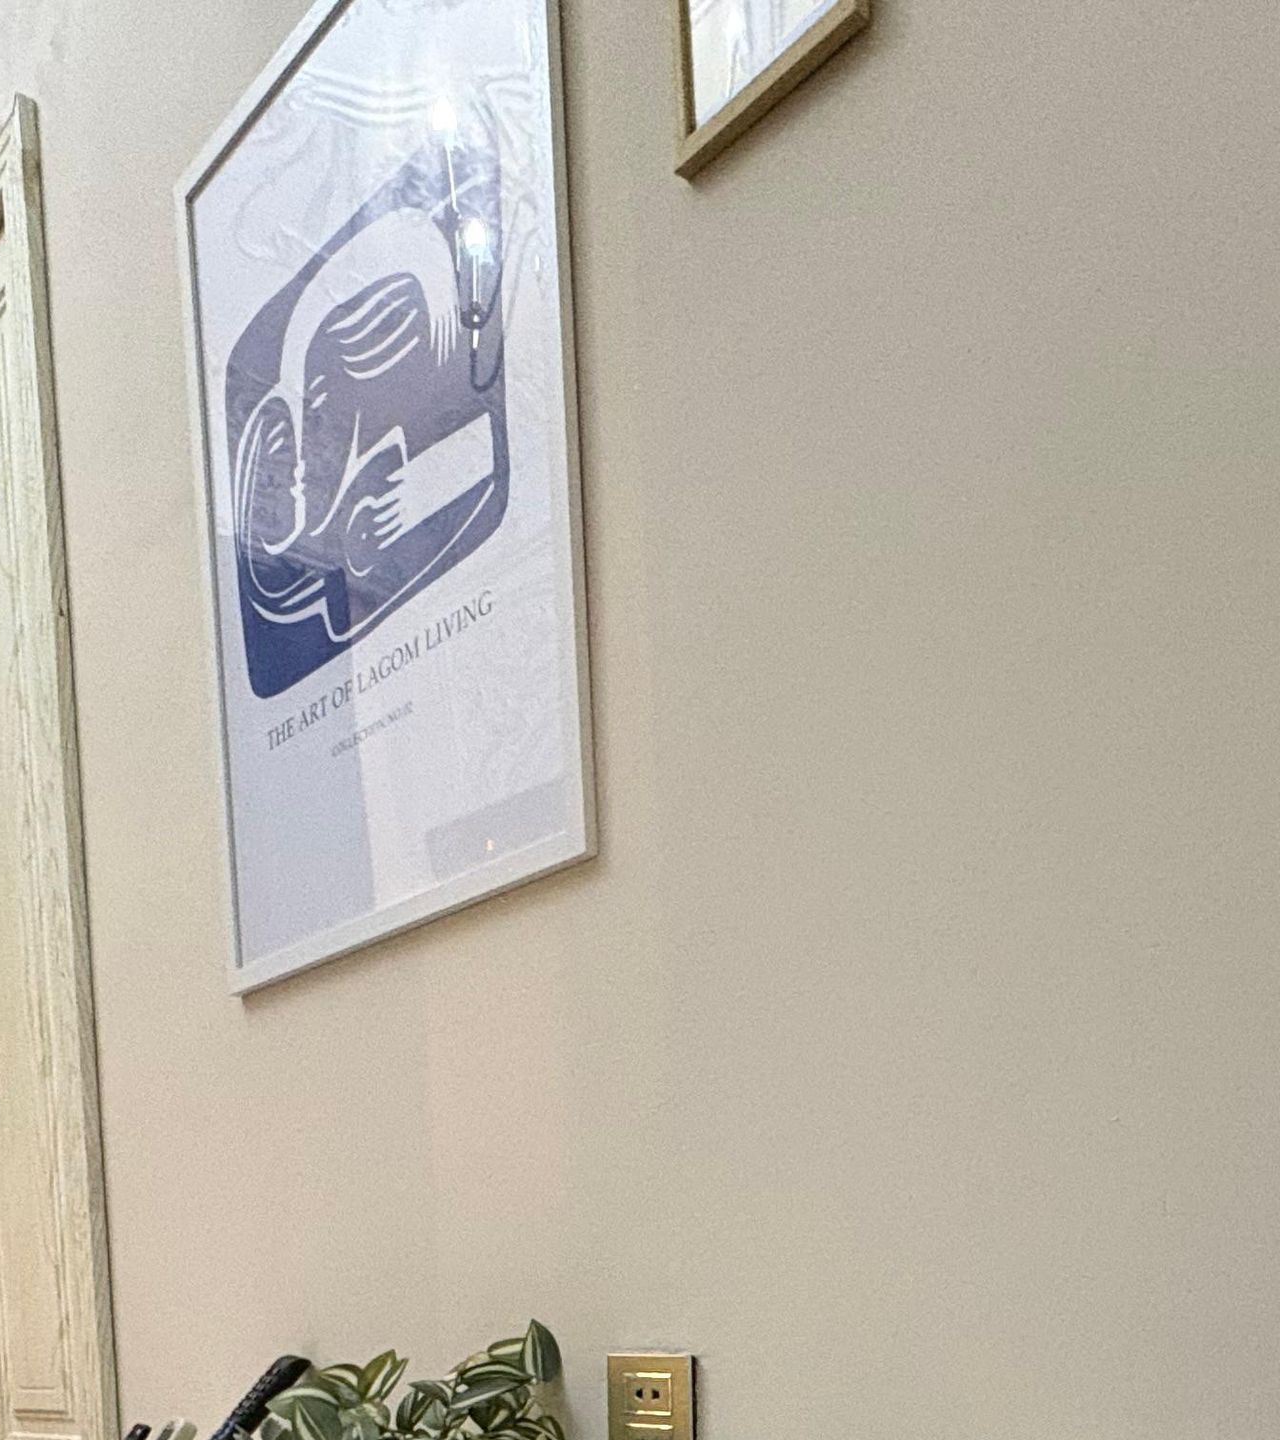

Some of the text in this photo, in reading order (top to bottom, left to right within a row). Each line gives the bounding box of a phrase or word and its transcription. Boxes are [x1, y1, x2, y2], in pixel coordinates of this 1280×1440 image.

[267, 717, 295, 751] THE
[299, 695, 328, 731] ART
[331, 679, 353, 710] OF
[357, 636, 421, 694] LAGOM
[425, 589, 493, 652] LIVING
